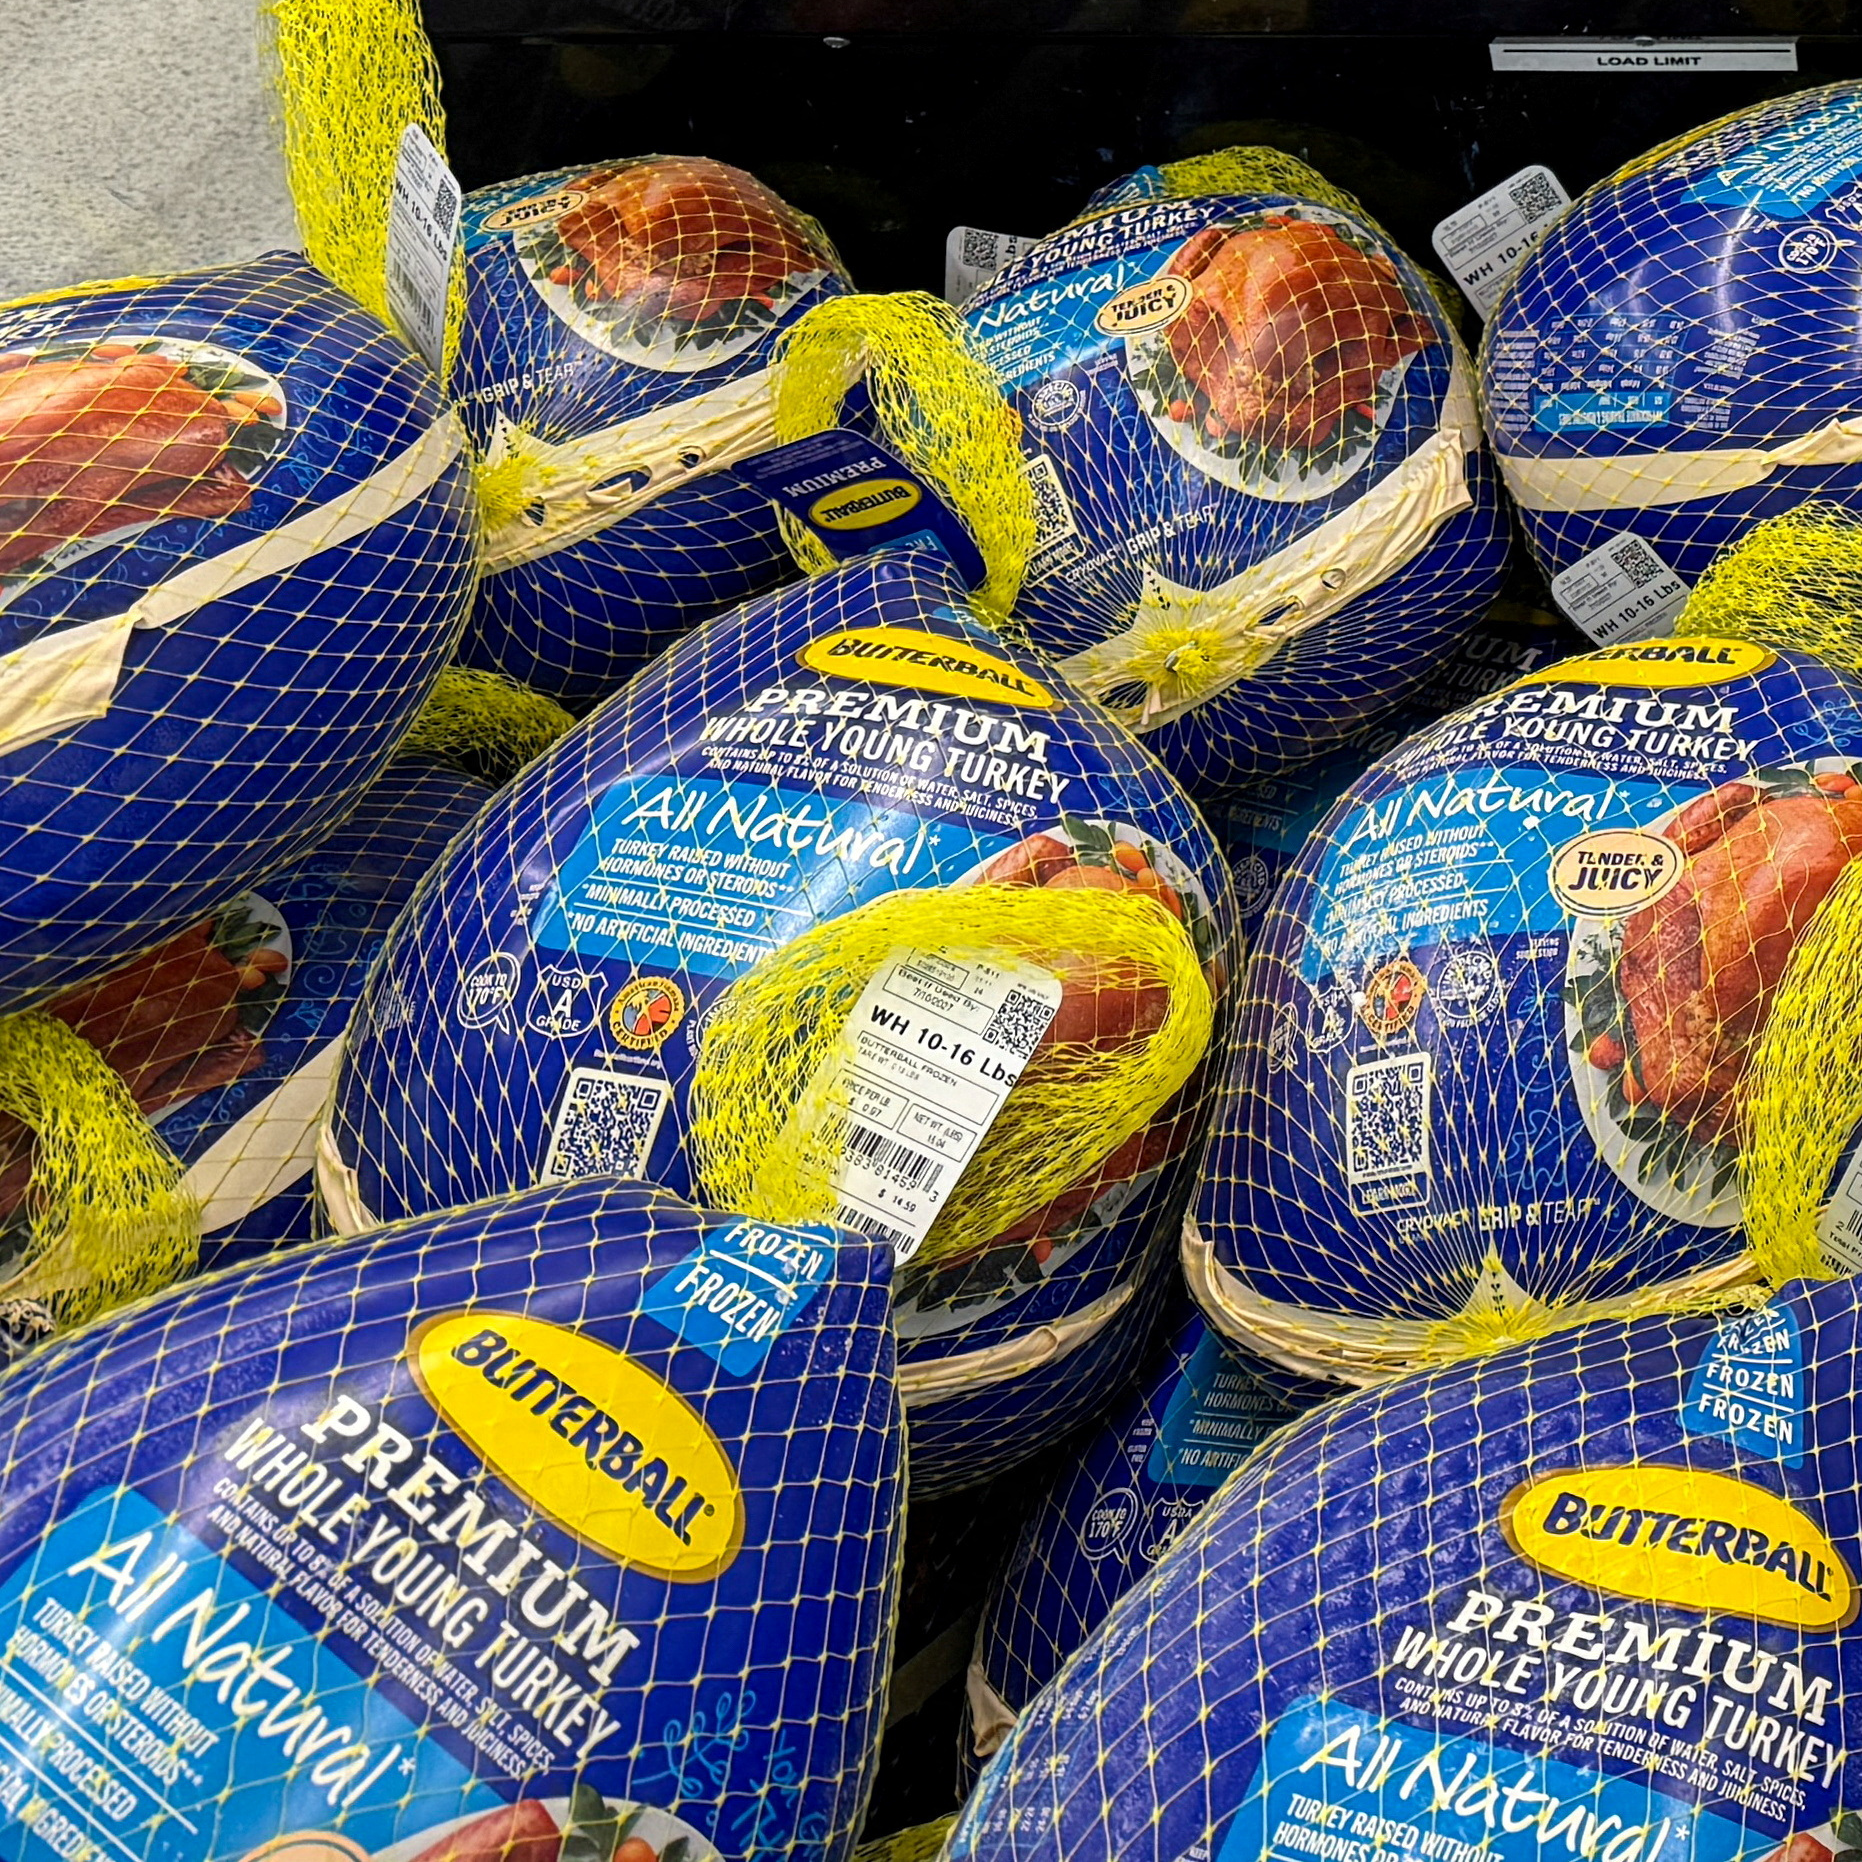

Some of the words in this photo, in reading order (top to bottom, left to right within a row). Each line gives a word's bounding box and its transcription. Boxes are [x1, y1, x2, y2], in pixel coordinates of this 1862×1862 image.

[1597, 57, 1648, 66] LOAD
[1654, 57, 1702, 66] LIMIT
[969, 263, 1126, 336] Natural
[1116, 294, 1177, 330] JUICY
[825, 636, 1035, 697] BUTTERBALL
[700, 713, 816, 755] WHOLE
[821, 723, 939, 774] YOUNG
[944, 743, 1069, 805] TURKEY
[745, 687, 1049, 764] PREMIUM
[1493, 715, 1621, 750] YOUNG
[1627, 725, 1759, 762] TURKEY
[622, 785, 709, 833] All
[1346, 801, 1402, 851] All
[611, 837, 664, 861] TURKEY
[723, 854, 792, 881] WITHOUT
[1566, 863, 1664, 891] JUICY
[867, 1006, 910, 1037] WH
[917, 1023, 976, 1068] 10-16
[979, 1055, 1019, 1089] Lbs
[676, 1263, 777, 1344] FROZEN
[1703, 1361, 1795, 1396] FROZEN
[450, 1329, 717, 1548] BUTTERBALL
[1697, 1393, 1795, 1444] FROZEN
[70, 1528, 181, 1627] All
[300, 1394, 641, 1690] PREMIUM
[1545, 1491, 1834, 1604] BUTTERBALL
[223, 1418, 370, 1543] WHOLE
[356, 1514, 487, 1648] YOUNG
[480, 1614, 622, 1761] TURKEY
[1445, 1590, 1834, 1724] PREMIUM
[1391, 1626, 1548, 1697] WHOLE
[1550, 1658, 1697, 1732] YOUNG
[1703, 1694, 1848, 1791] TURKEY
[1298, 1724, 1398, 1799] All
